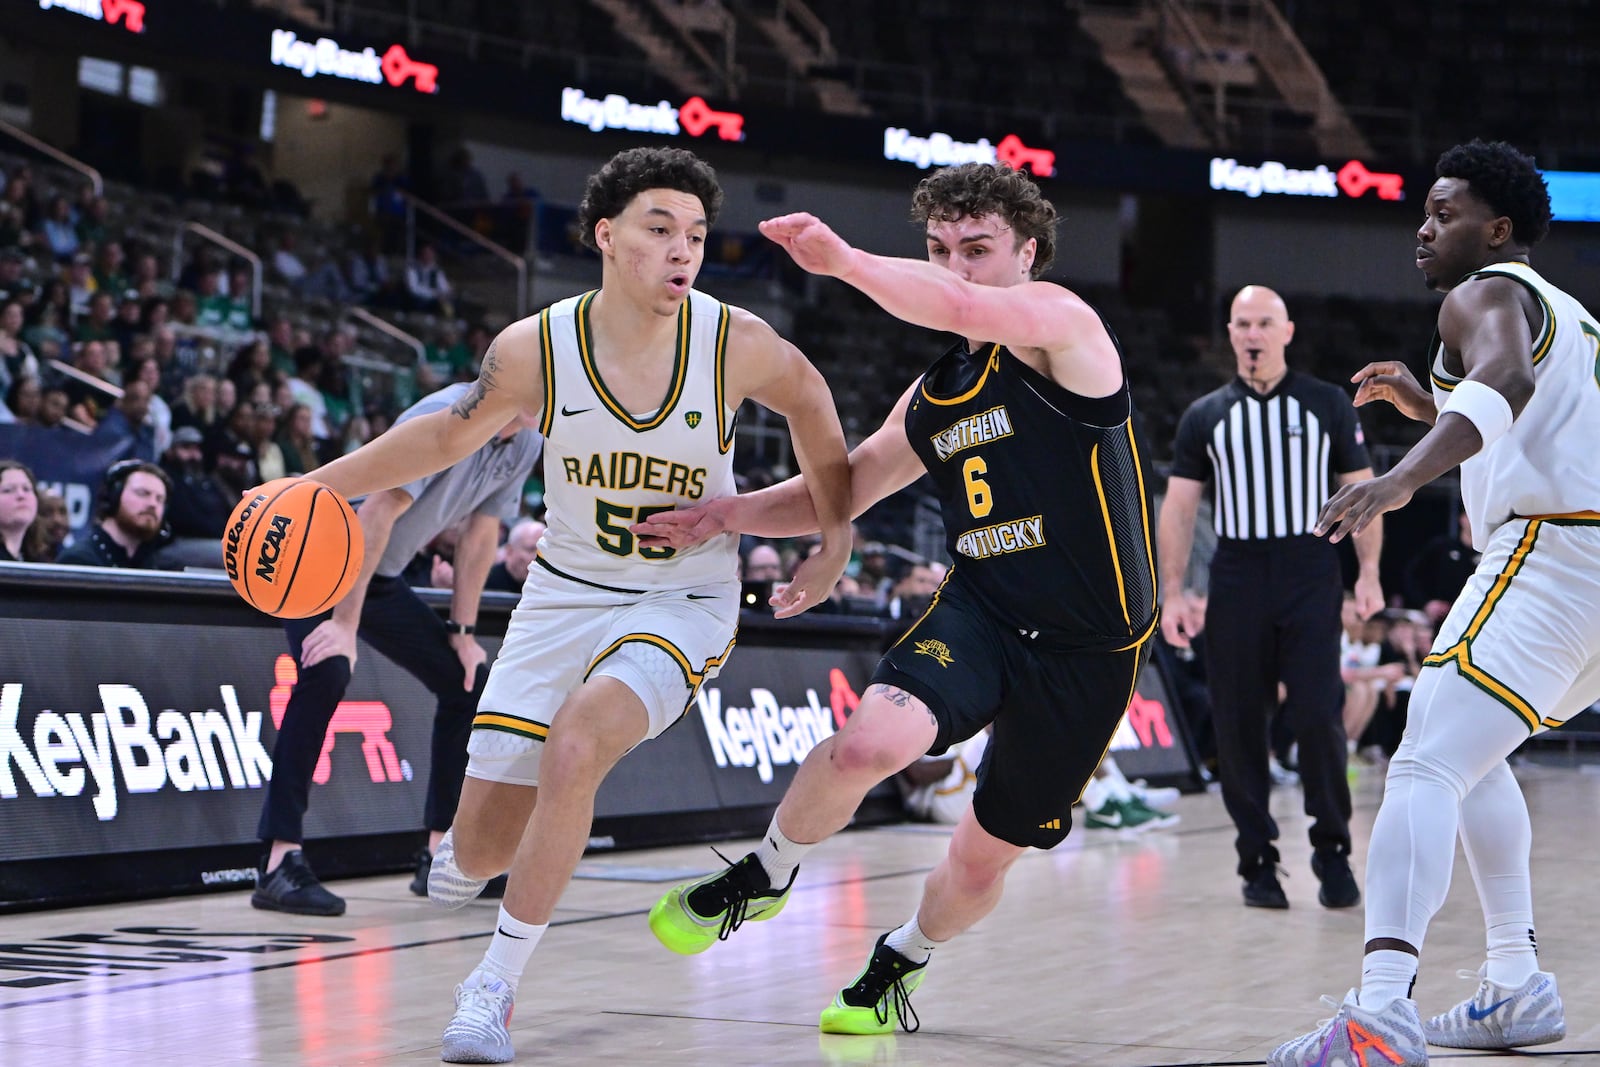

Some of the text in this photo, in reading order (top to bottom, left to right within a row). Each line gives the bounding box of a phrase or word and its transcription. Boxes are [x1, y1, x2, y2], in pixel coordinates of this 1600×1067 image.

[271, 29, 383, 85] KeyBank
[561, 87, 680, 135] KeyBank
[1209, 157, 1338, 198] KeyBank
[562, 452, 707, 500] RAIDERS
[962, 455, 993, 519] 6
[255, 513, 293, 584] NCAA
[0, 684, 273, 821] KeyBank
